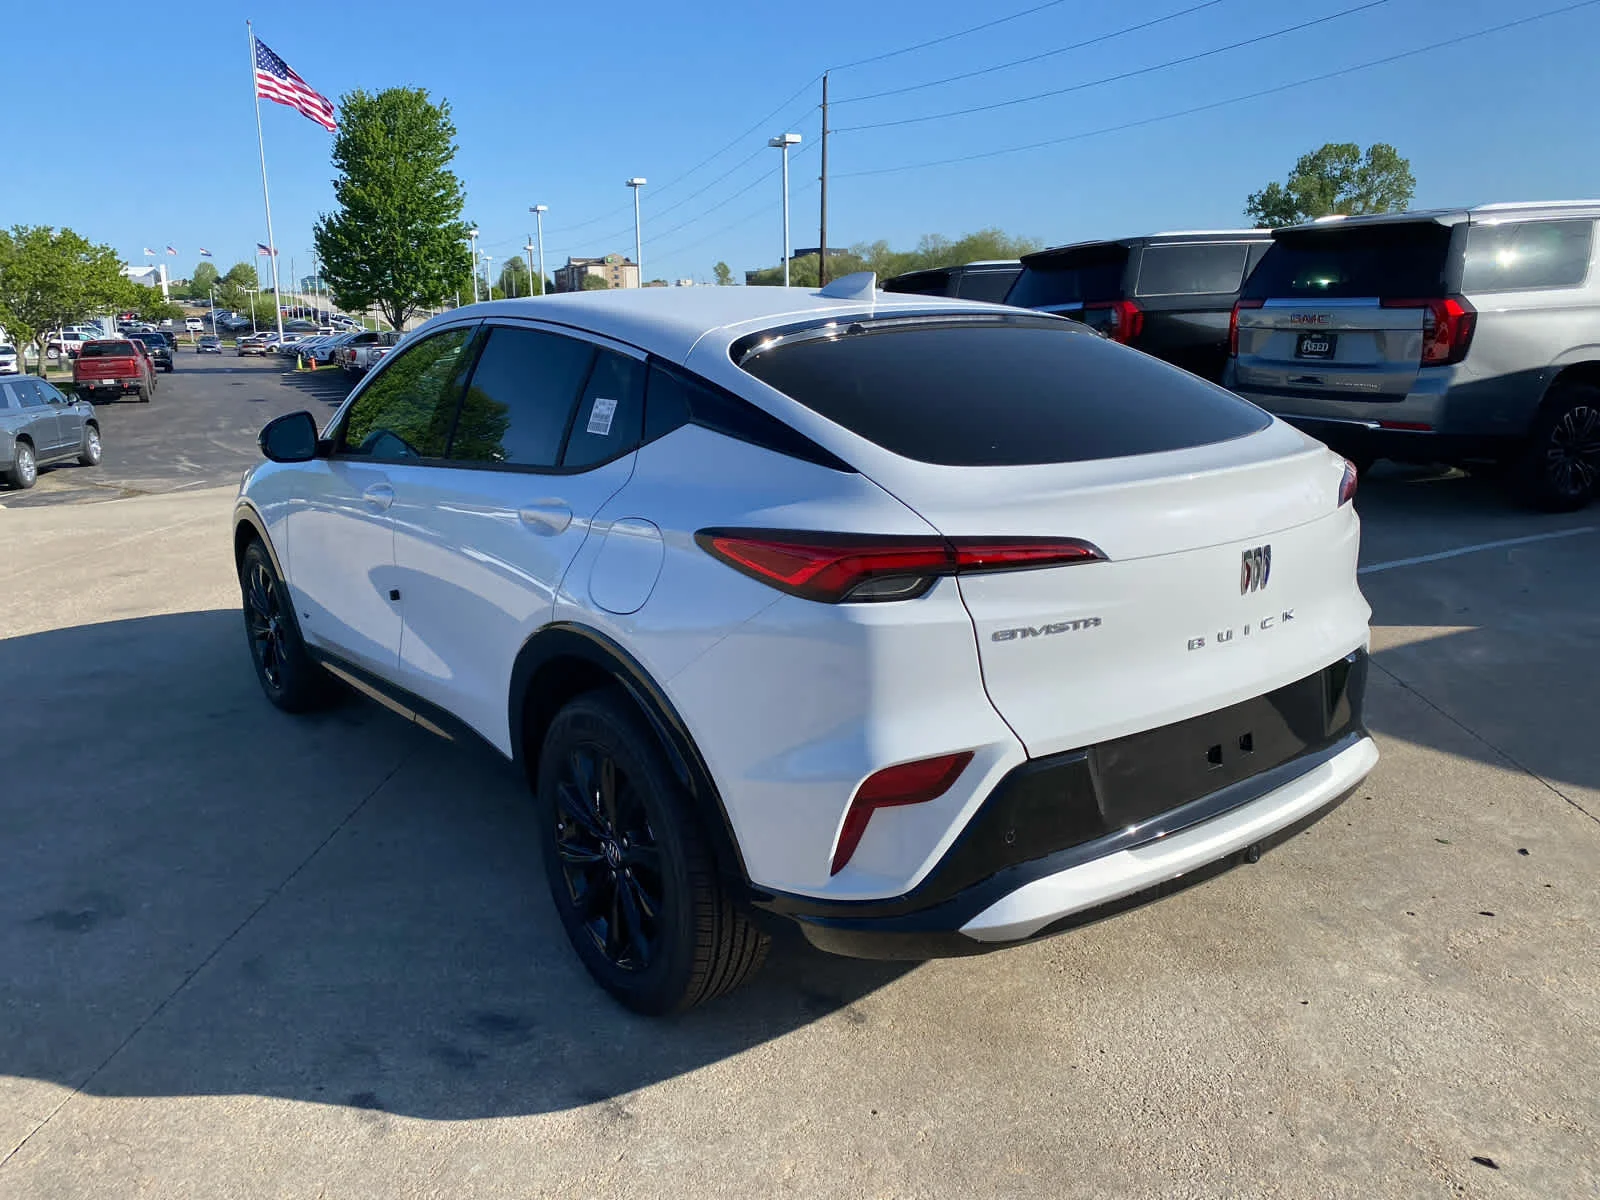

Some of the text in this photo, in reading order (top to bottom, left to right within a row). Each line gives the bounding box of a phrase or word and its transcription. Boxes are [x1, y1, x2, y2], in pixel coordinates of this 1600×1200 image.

[1290, 312, 1330, 325] GMC
[991, 617, 1102, 642] ENVISTA
[1187, 608, 1295, 651] BUICK
